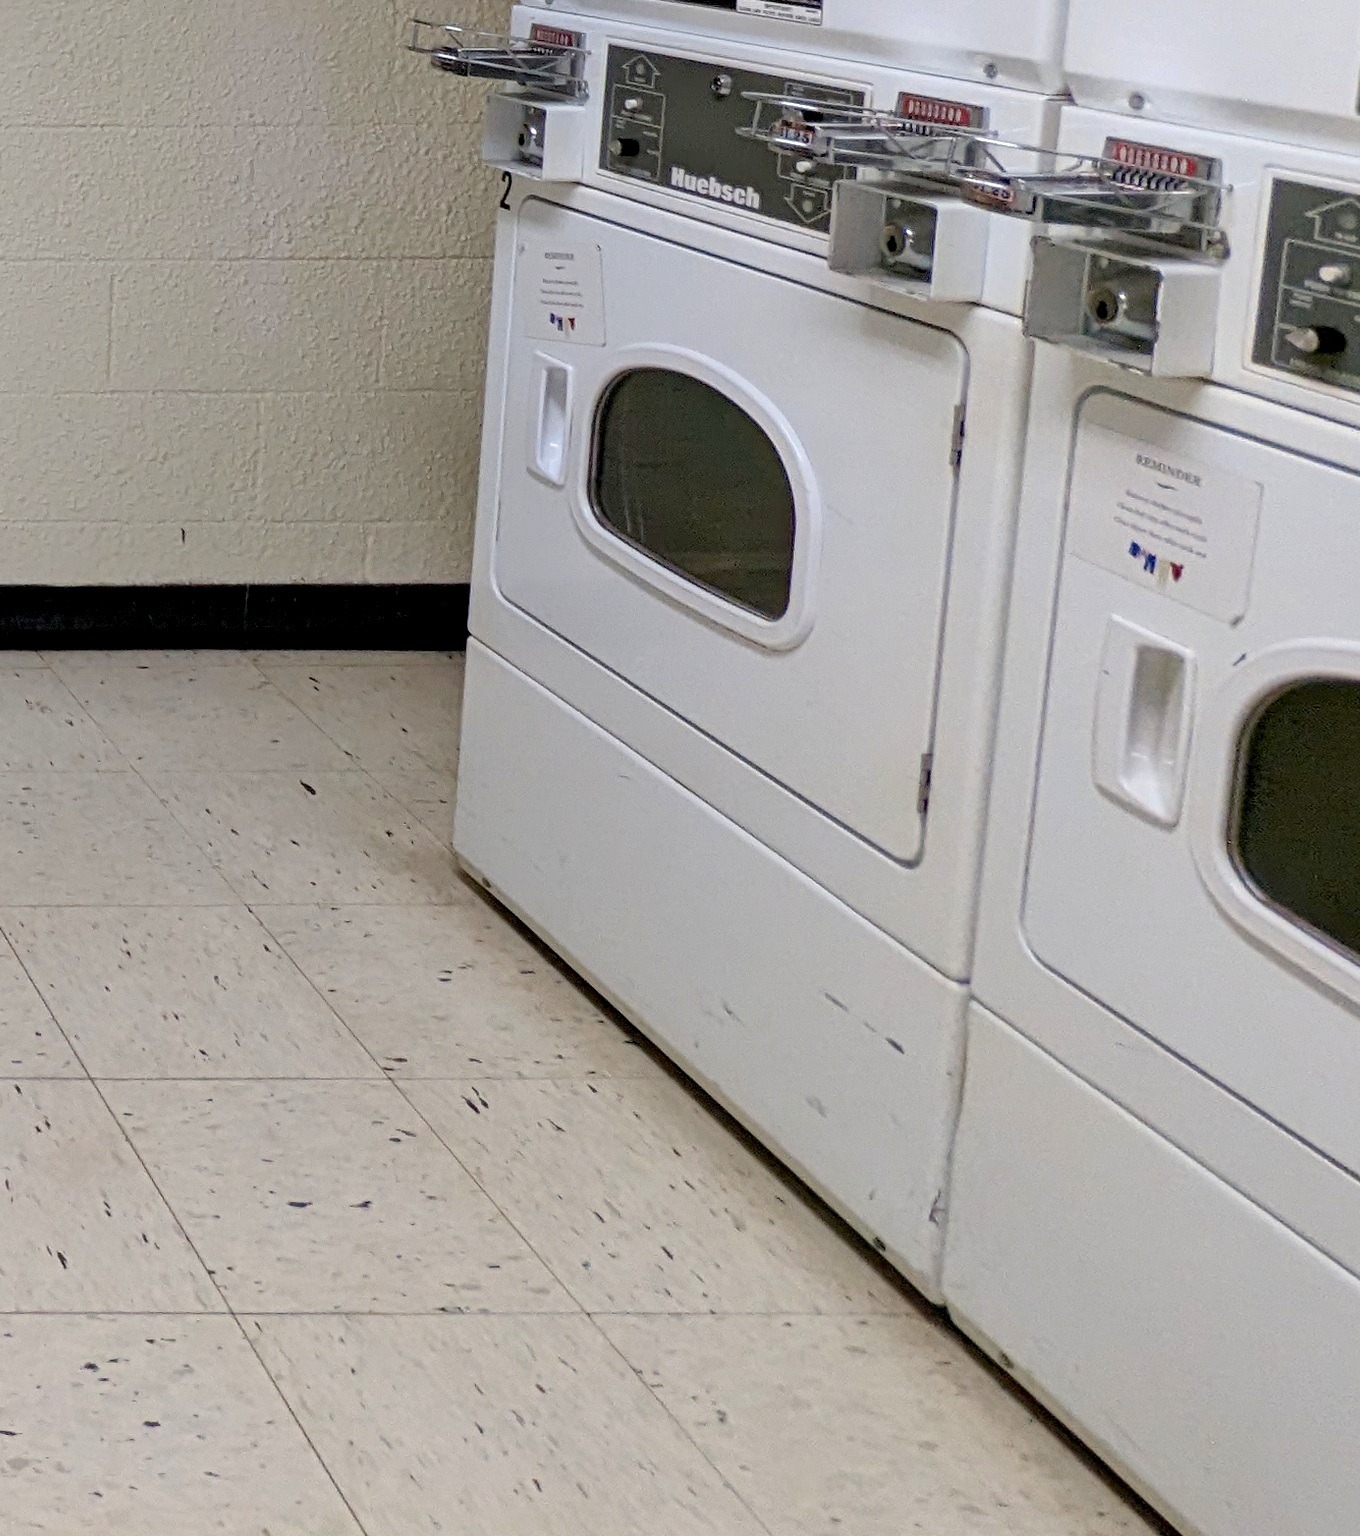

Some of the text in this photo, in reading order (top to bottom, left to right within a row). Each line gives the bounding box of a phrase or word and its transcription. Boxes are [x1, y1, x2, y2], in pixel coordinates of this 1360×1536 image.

[499, 171, 513, 211] 2
[670, 166, 760, 210] Huebsch
[1135, 453, 1202, 488] REMINDER
